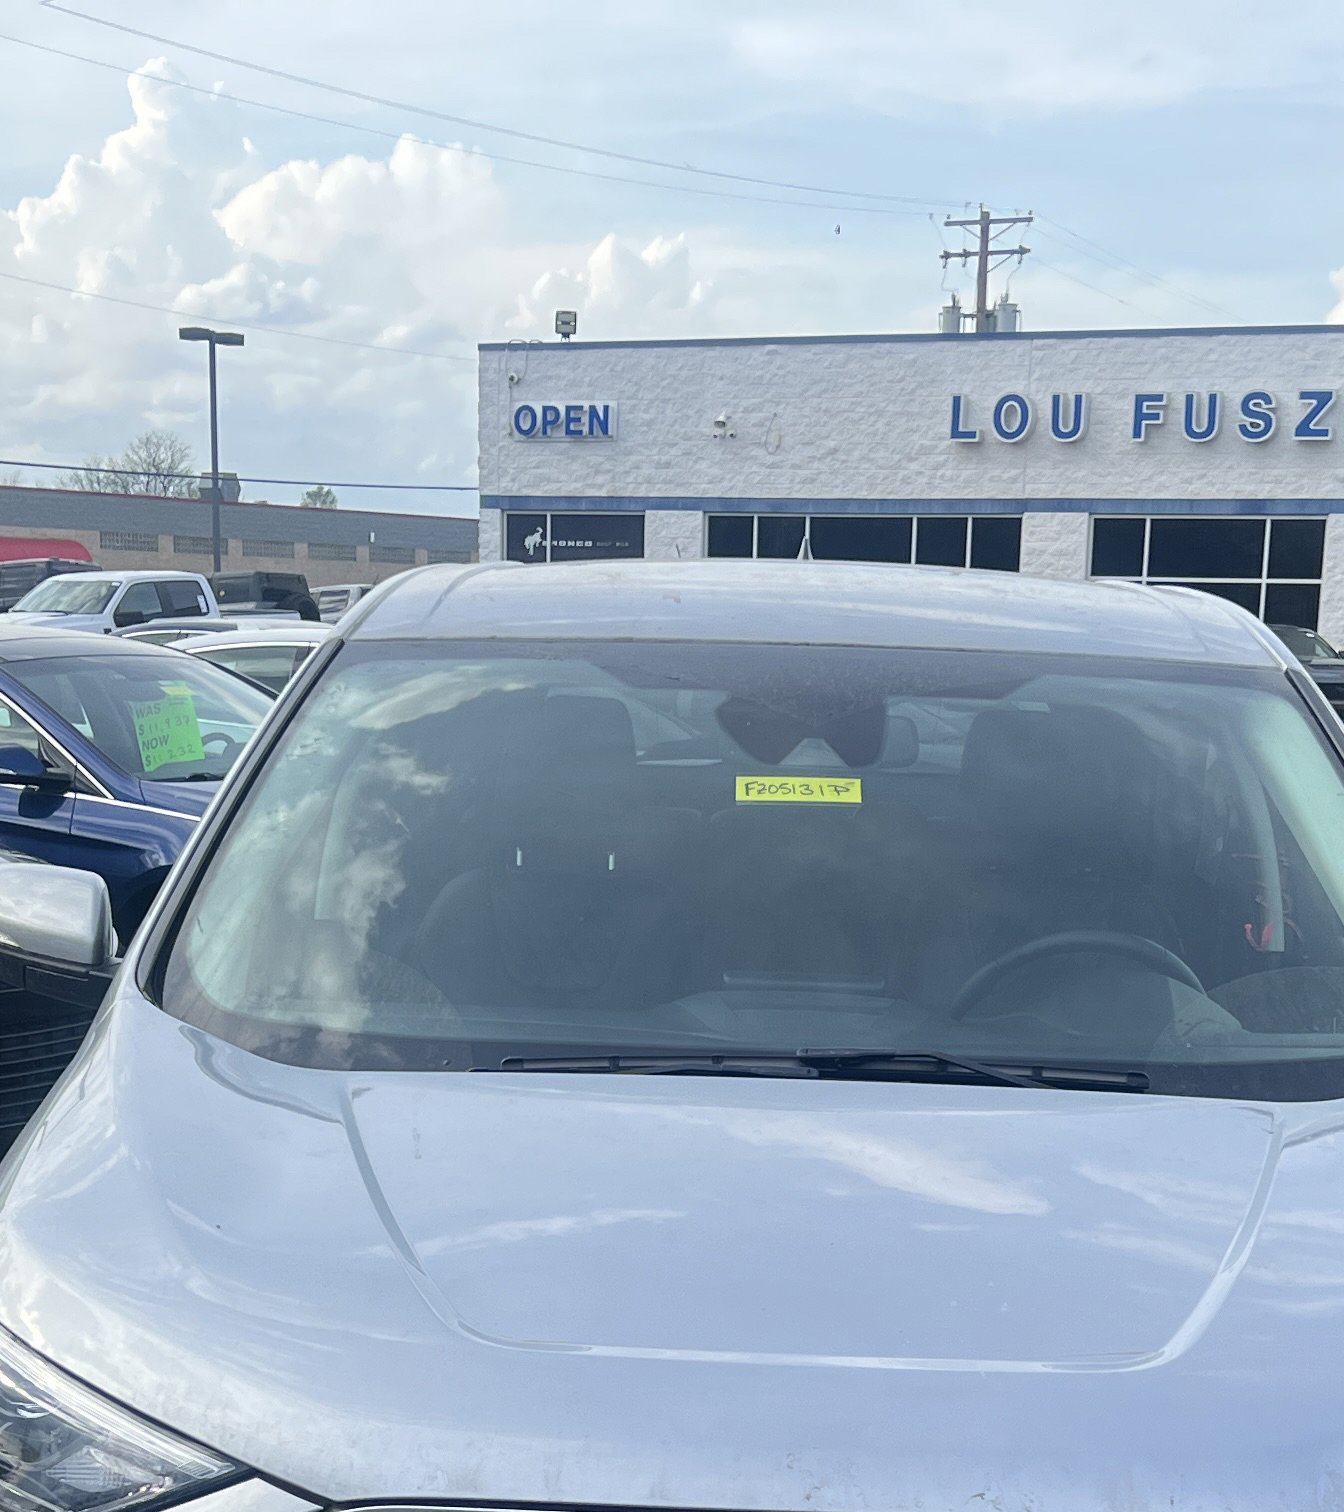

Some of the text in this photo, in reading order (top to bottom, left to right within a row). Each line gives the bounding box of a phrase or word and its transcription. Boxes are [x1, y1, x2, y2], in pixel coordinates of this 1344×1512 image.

[513, 403, 611, 438] OPEN
[949, 389, 1336, 441] LOU FUSZ
[135, 702, 161, 719] WAS
[141, 734, 170, 752] NOW
